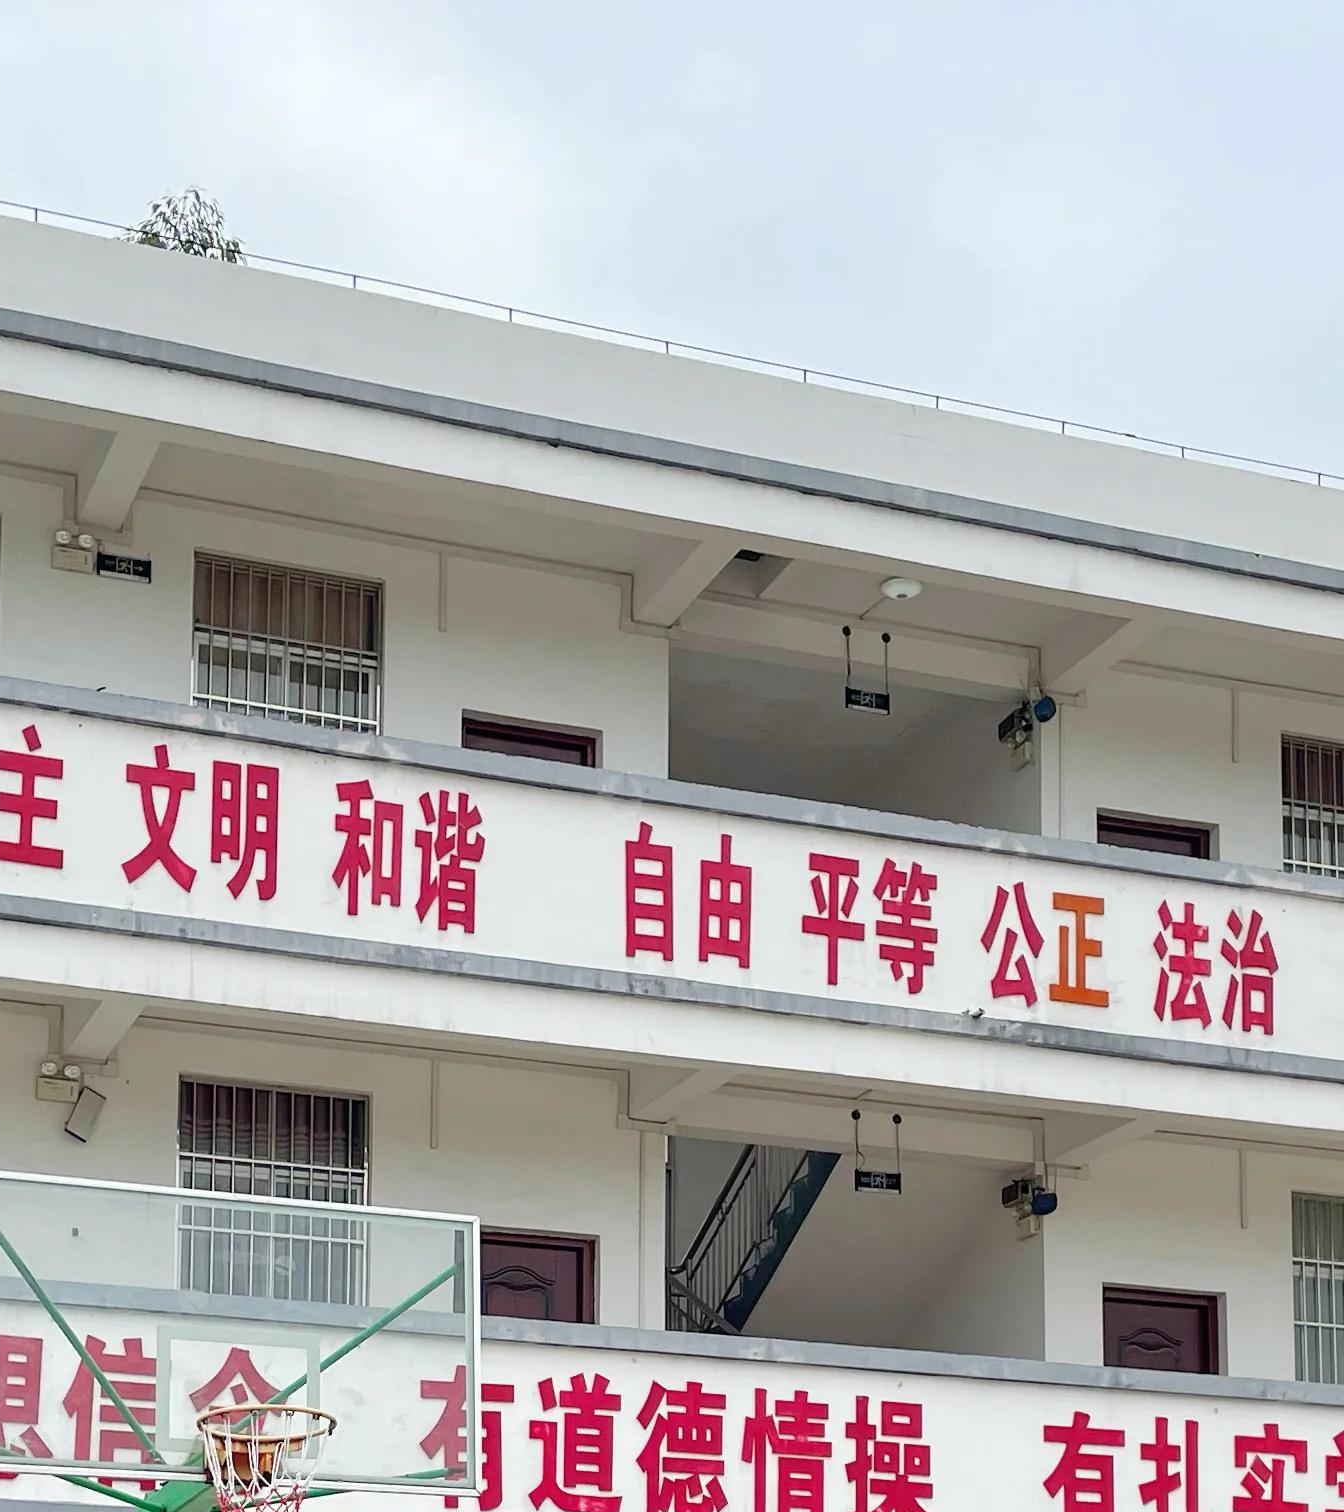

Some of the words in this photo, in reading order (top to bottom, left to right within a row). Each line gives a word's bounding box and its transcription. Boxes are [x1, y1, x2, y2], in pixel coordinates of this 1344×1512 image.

[122, 745, 279, 900] 文明
[332, 780, 485, 933] 和谐
[625, 822, 751, 968] 自由
[802, 853, 937, 994] 平等
[981, 882, 1109, 1007] 公正
[1154, 901, 1278, 1035] 法治
